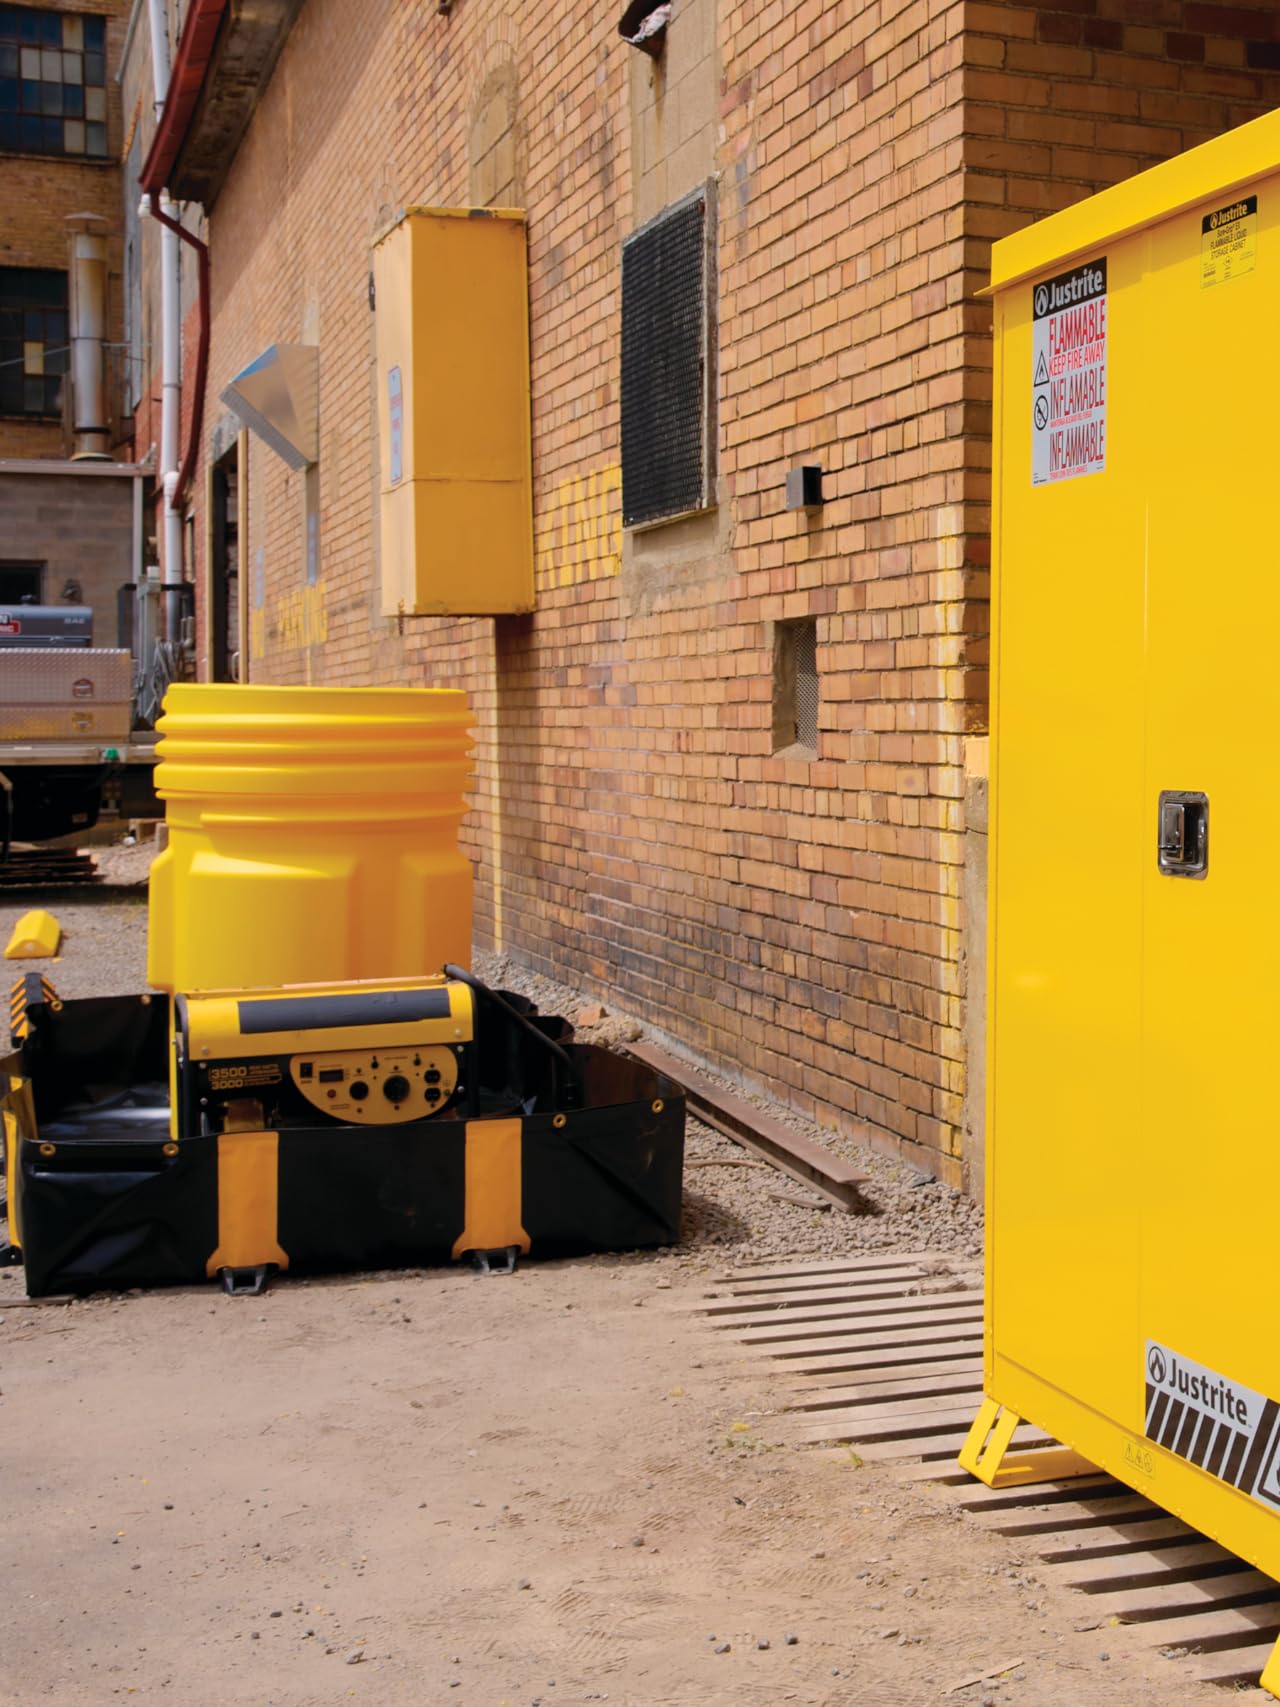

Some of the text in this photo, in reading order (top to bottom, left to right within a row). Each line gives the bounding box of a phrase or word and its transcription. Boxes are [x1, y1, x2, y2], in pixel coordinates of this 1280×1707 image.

[1218, 203, 1248, 226] Justrite
[1049, 268, 1103, 310] Justrite
[1049, 299, 1105, 357] FLAMMABLE
[1049, 340, 1105, 377] KEEP FIRE AWAY
[1050, 364, 1105, 420] INFLAMABLE
[1049, 419, 1105, 473] INFLAMMABLE
[211, 1066, 248, 1079] 3500
[211, 1079, 244, 1091] 3000
[1169, 1357, 1248, 1426] Justrite
